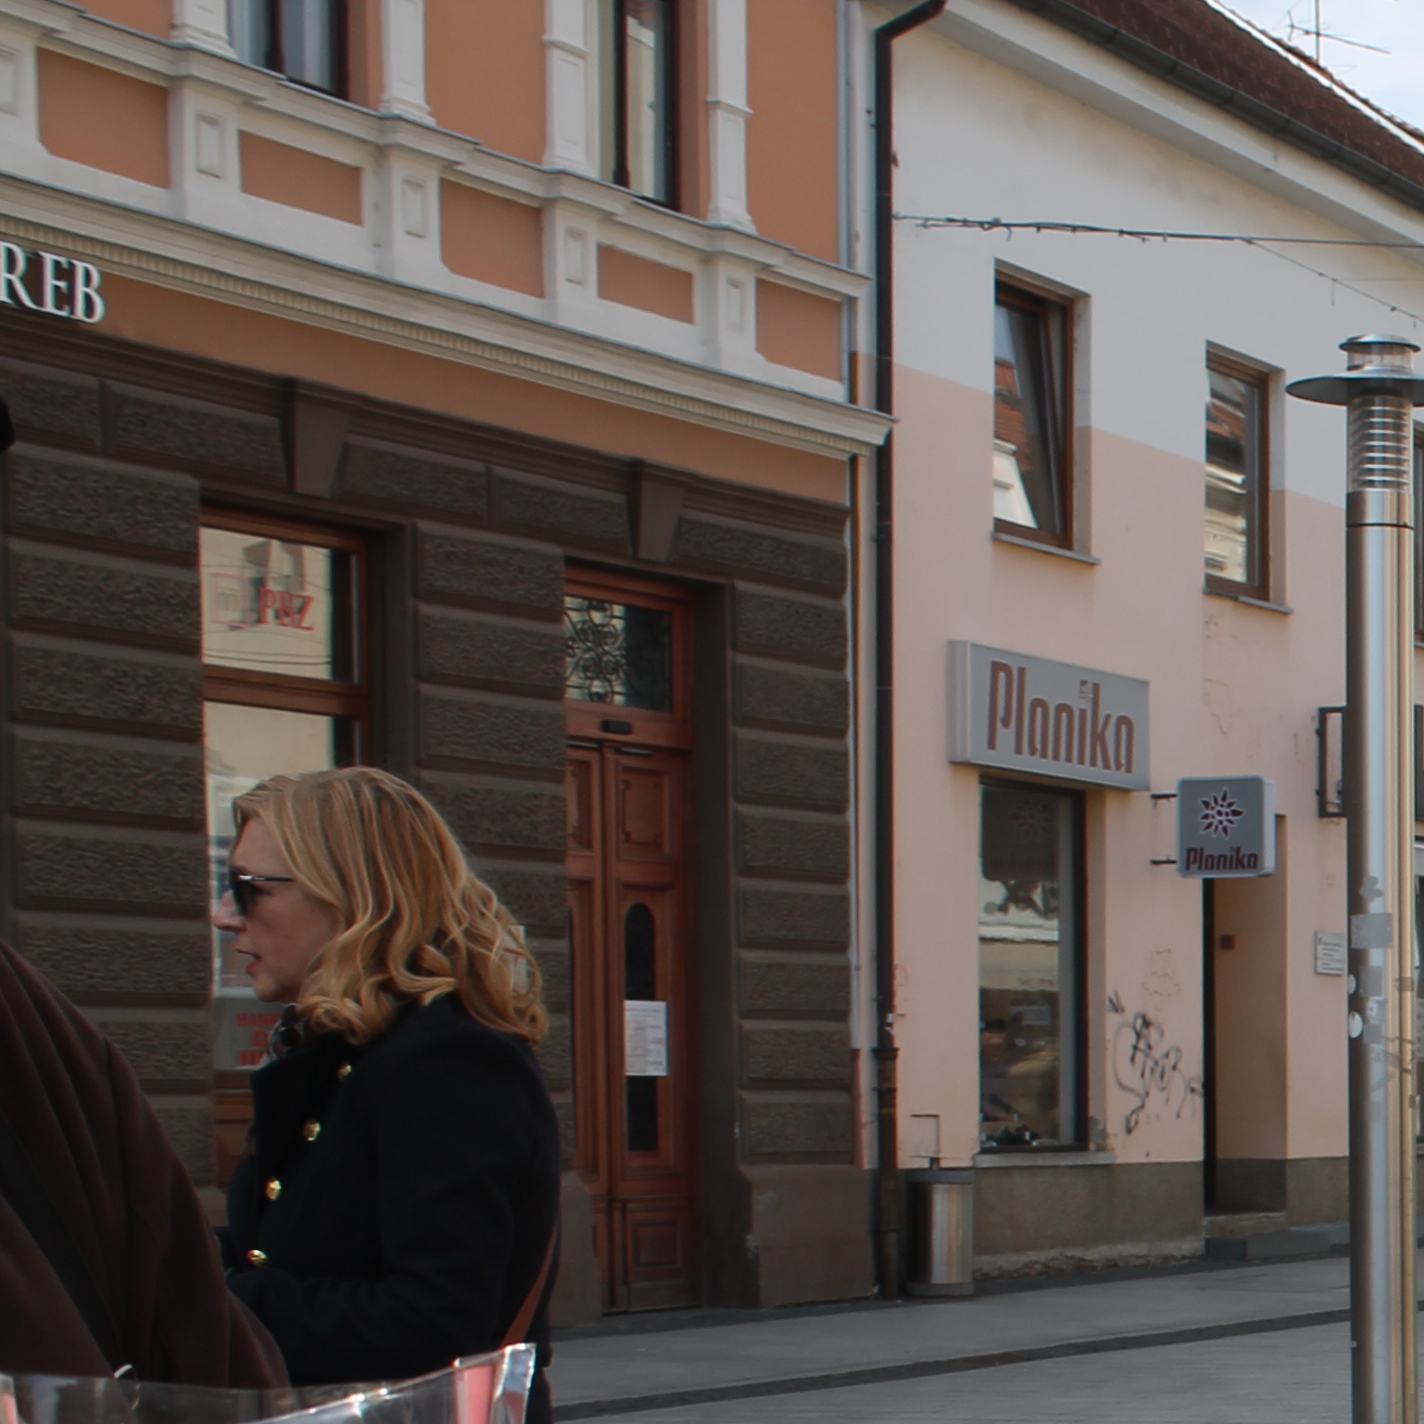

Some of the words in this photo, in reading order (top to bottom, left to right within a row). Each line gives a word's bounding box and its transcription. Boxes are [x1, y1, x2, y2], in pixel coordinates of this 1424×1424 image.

[259, 587, 314, 631] PBZ
[987, 659, 1135, 774] Planika
[1185, 847, 1259, 872] Planika
